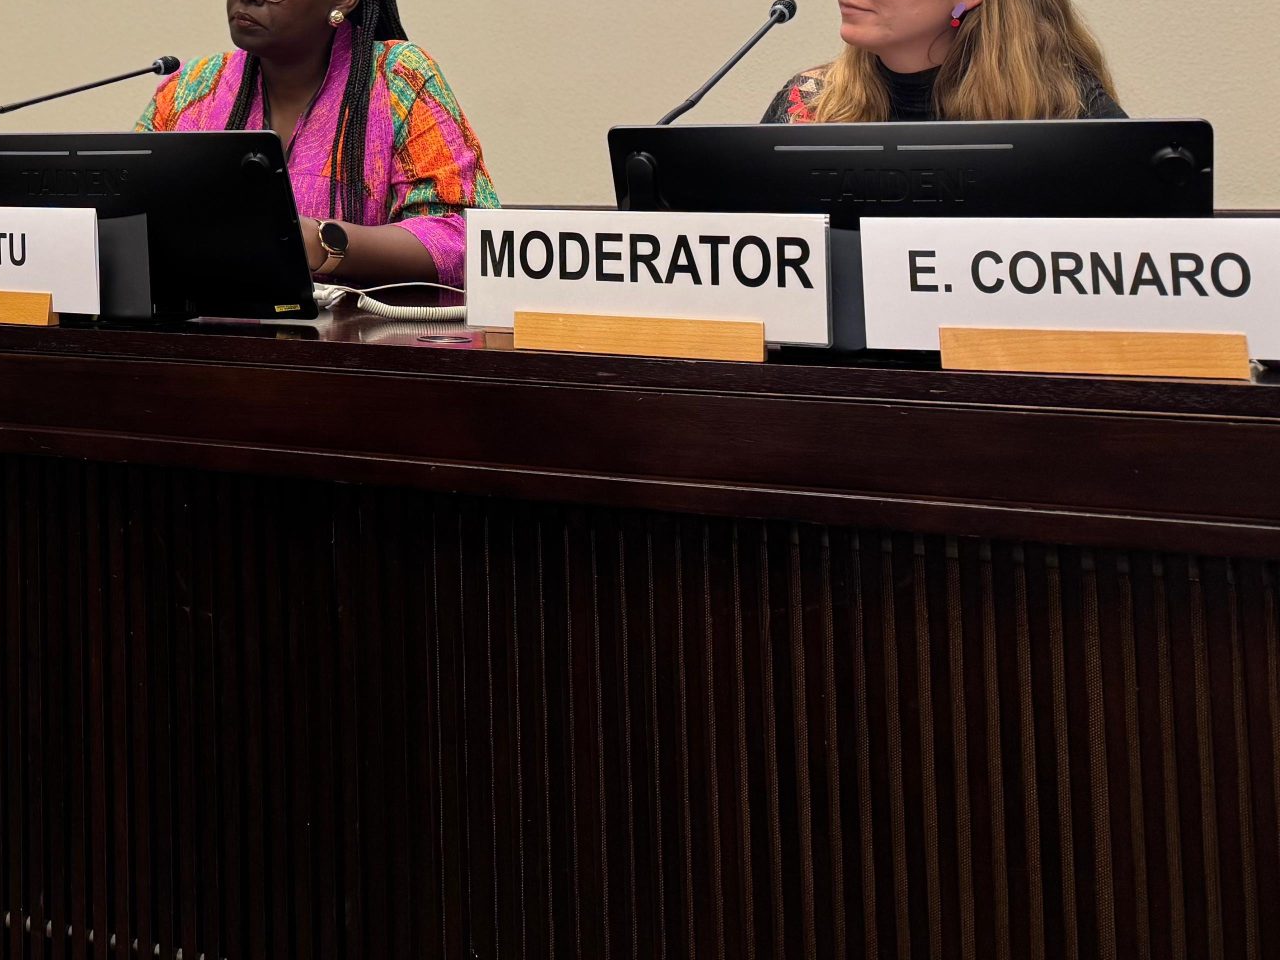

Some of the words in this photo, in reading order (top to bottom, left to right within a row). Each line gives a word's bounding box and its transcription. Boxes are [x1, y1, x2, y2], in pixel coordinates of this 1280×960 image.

[480, 229, 814, 289] MODERATOR
[908, 250, 953, 293] E.
[970, 250, 1251, 298] CORNARO
